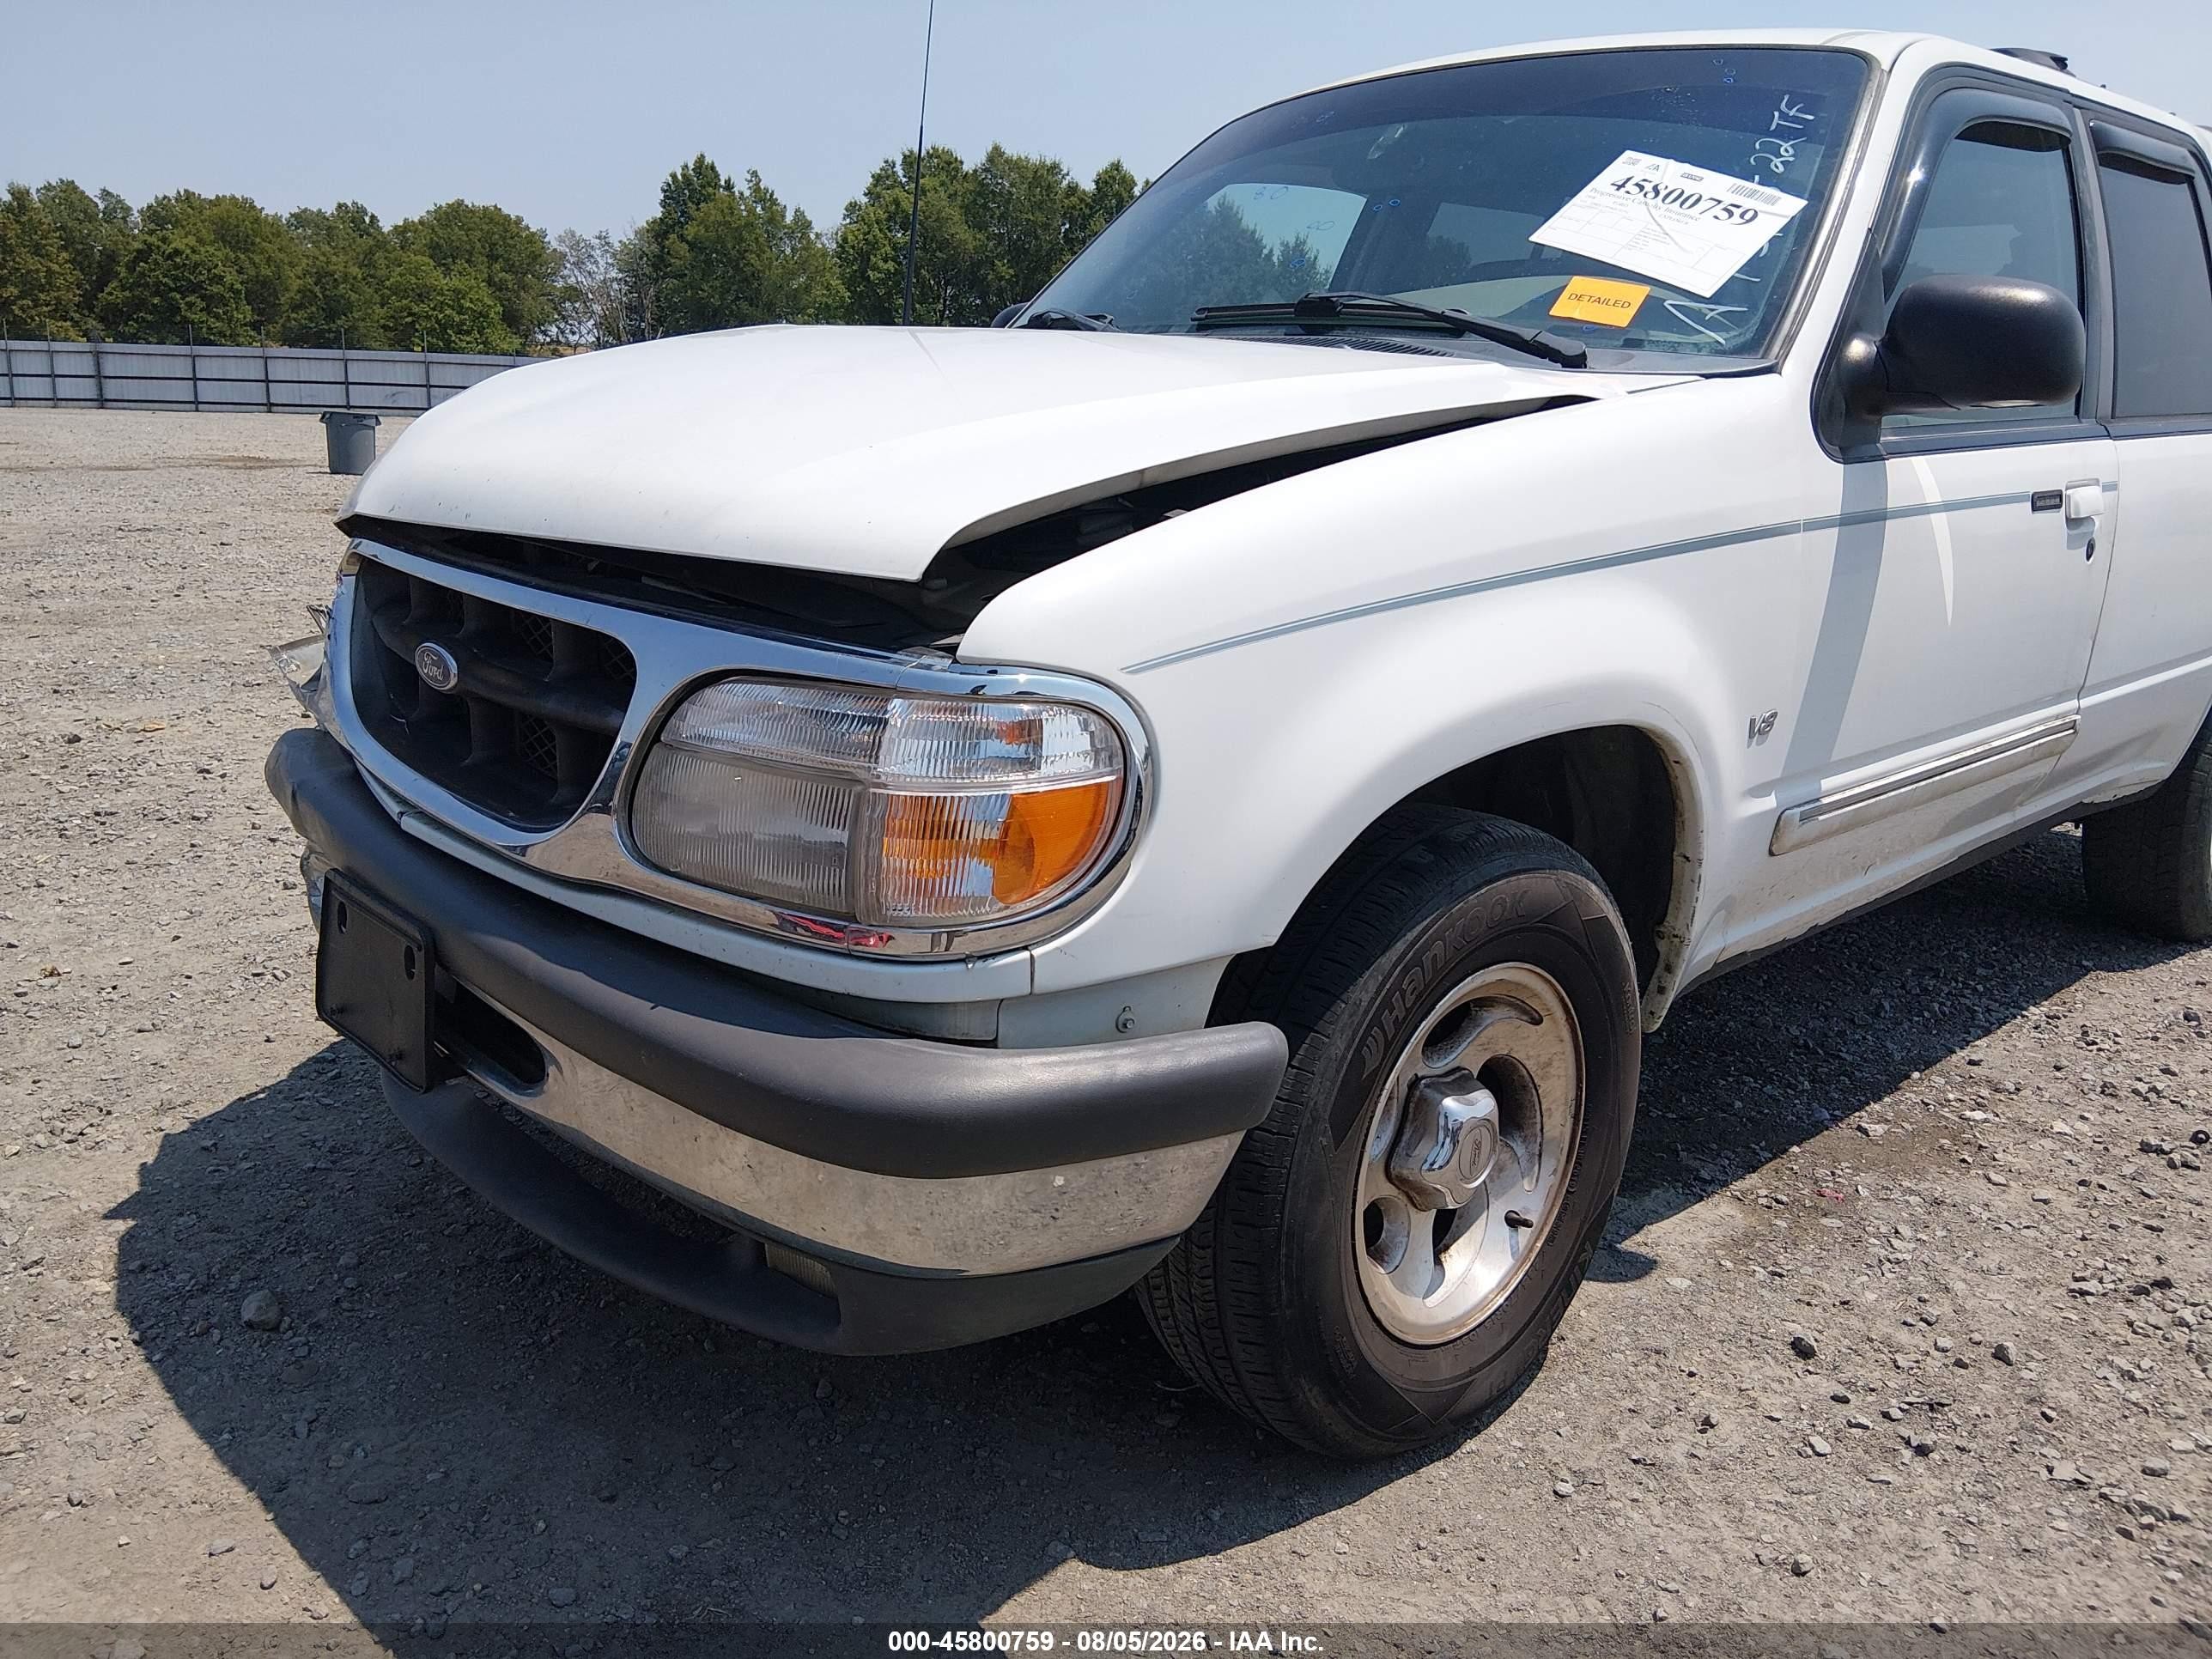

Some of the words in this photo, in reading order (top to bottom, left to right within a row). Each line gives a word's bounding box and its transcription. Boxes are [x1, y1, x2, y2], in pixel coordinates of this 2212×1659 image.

[1610, 175, 1759, 226] 45800759
[1567, 292, 1632, 309] DETAILED
[424, 653, 443, 681] Ford
[1748, 709, 1778, 740] V8
